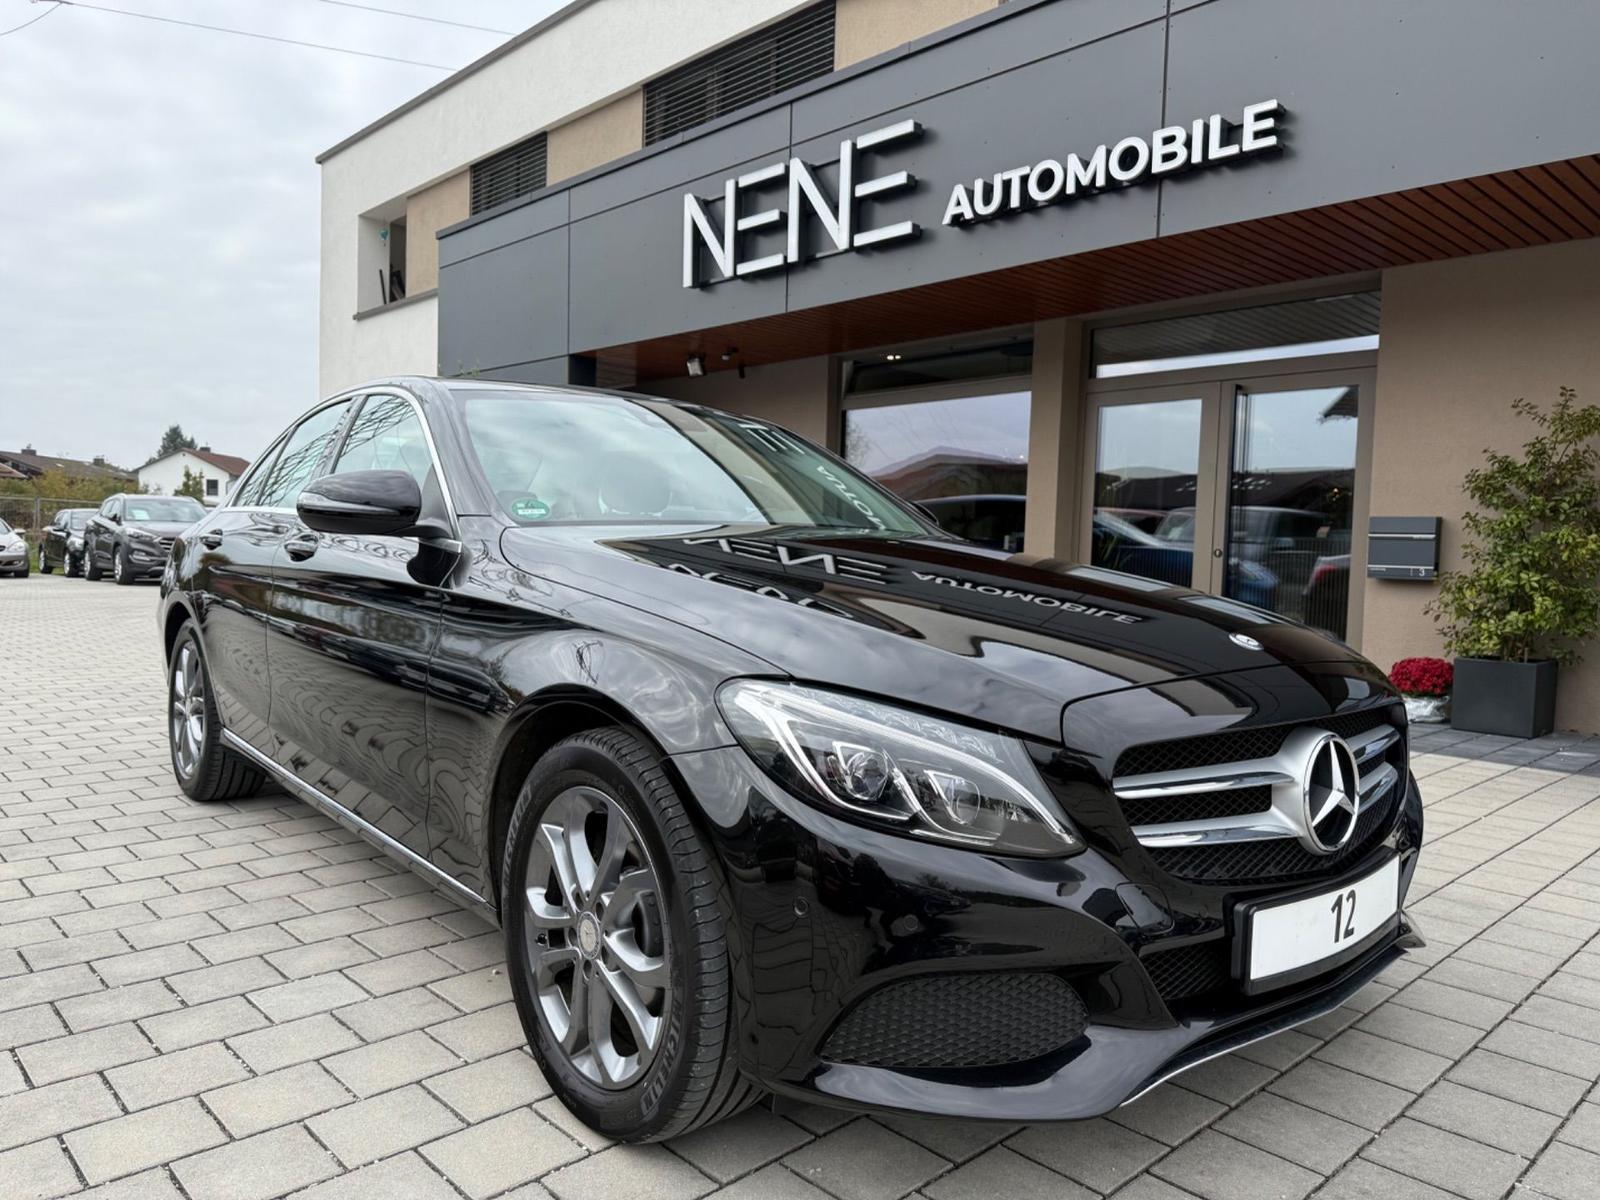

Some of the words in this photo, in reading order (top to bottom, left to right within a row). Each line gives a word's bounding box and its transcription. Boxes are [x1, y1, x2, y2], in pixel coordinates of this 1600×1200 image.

[683, 119, 922, 288] NENE
[942, 98, 1285, 226] AUTOMOBILE
[1331, 889, 1357, 944] 12
[640, 999, 682, 1116] MICHELIN
